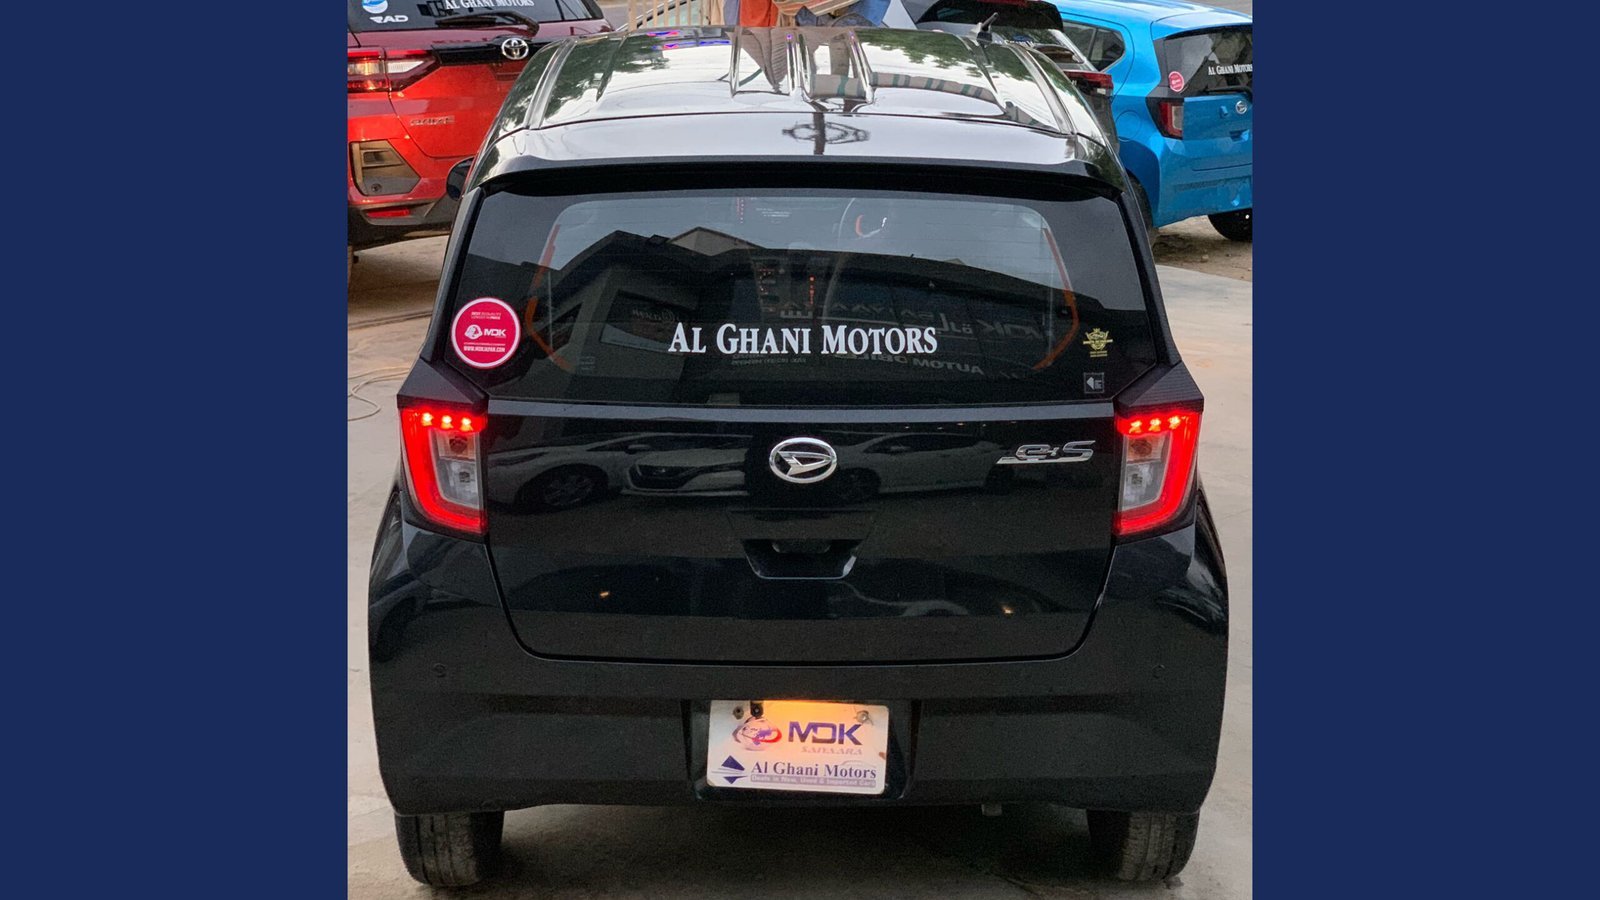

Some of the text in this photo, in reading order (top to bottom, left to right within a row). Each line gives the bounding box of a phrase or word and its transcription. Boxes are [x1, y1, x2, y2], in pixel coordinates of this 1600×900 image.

[484, 328, 506, 336] MDK
[668, 322, 938, 355] AL GHANI MOTORS
[788, 721, 863, 746] MDK
[751, 761, 877, 779] Al Ghani Motors
